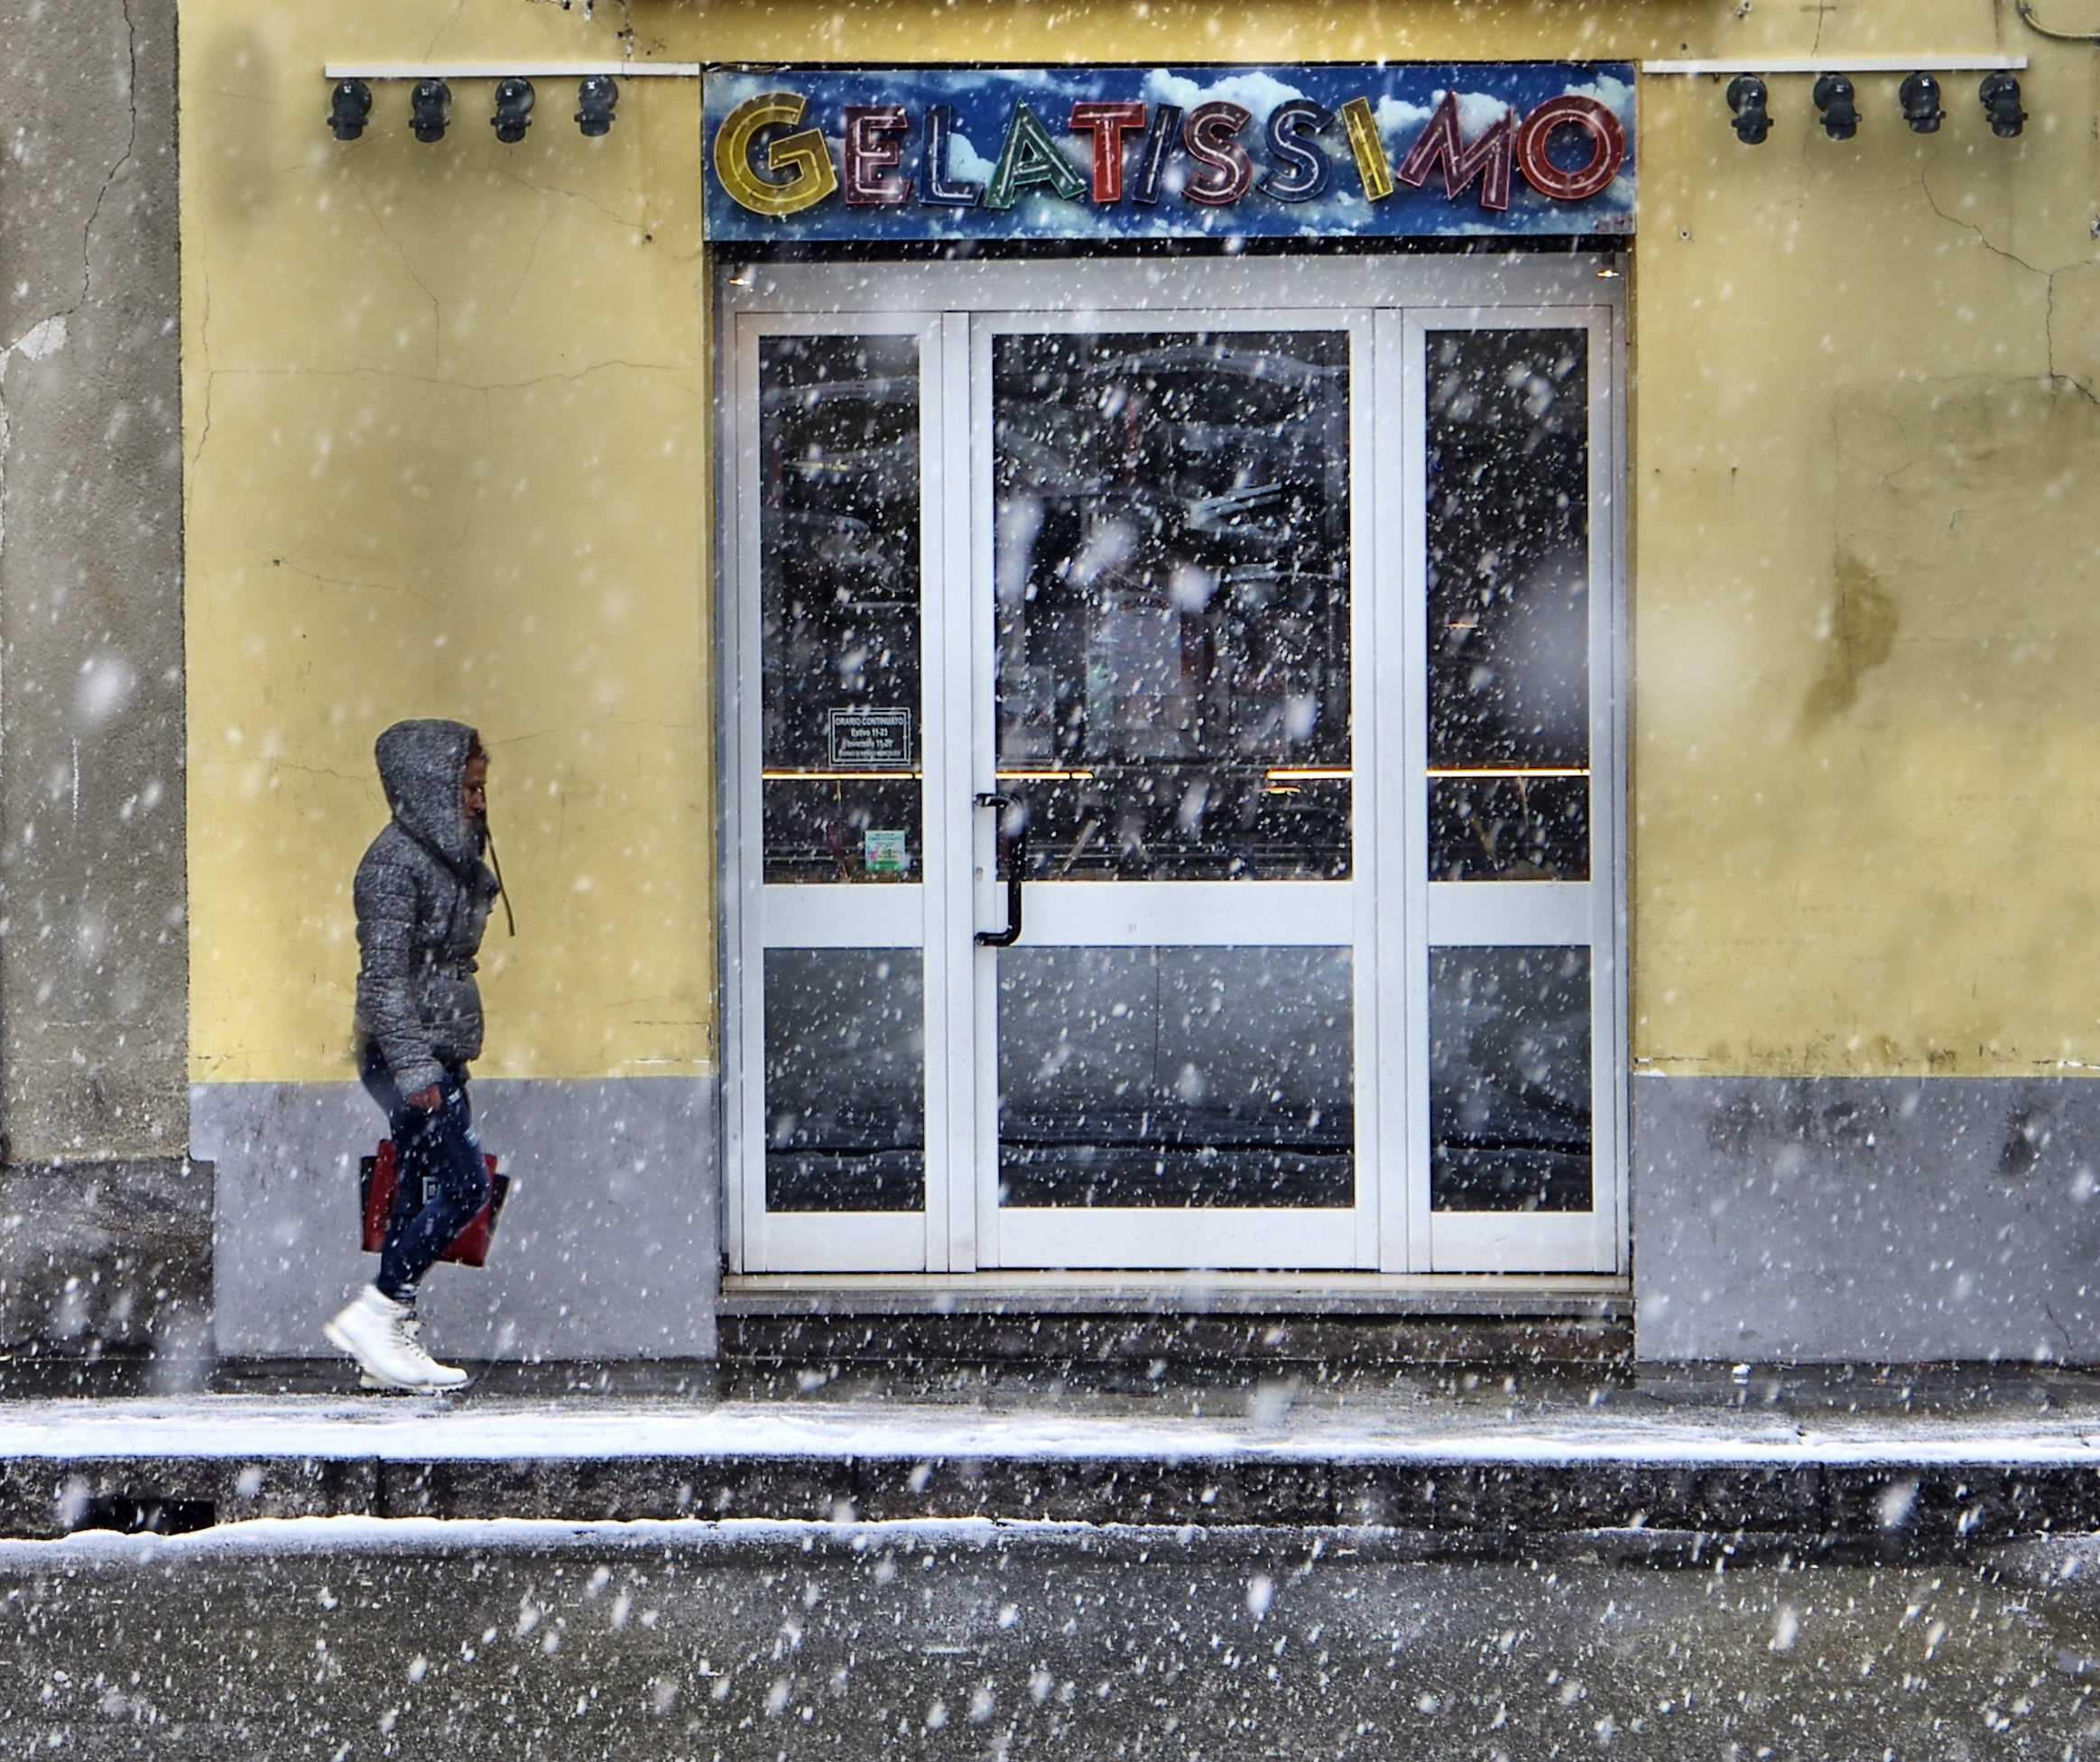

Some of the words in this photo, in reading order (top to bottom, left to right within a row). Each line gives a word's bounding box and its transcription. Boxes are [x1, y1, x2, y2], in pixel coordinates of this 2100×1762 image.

[714, 89, 1625, 217] GELATISSIMO
[835, 716, 861, 726] ORARIO
[862, 716, 904, 726] CONTINUATO
